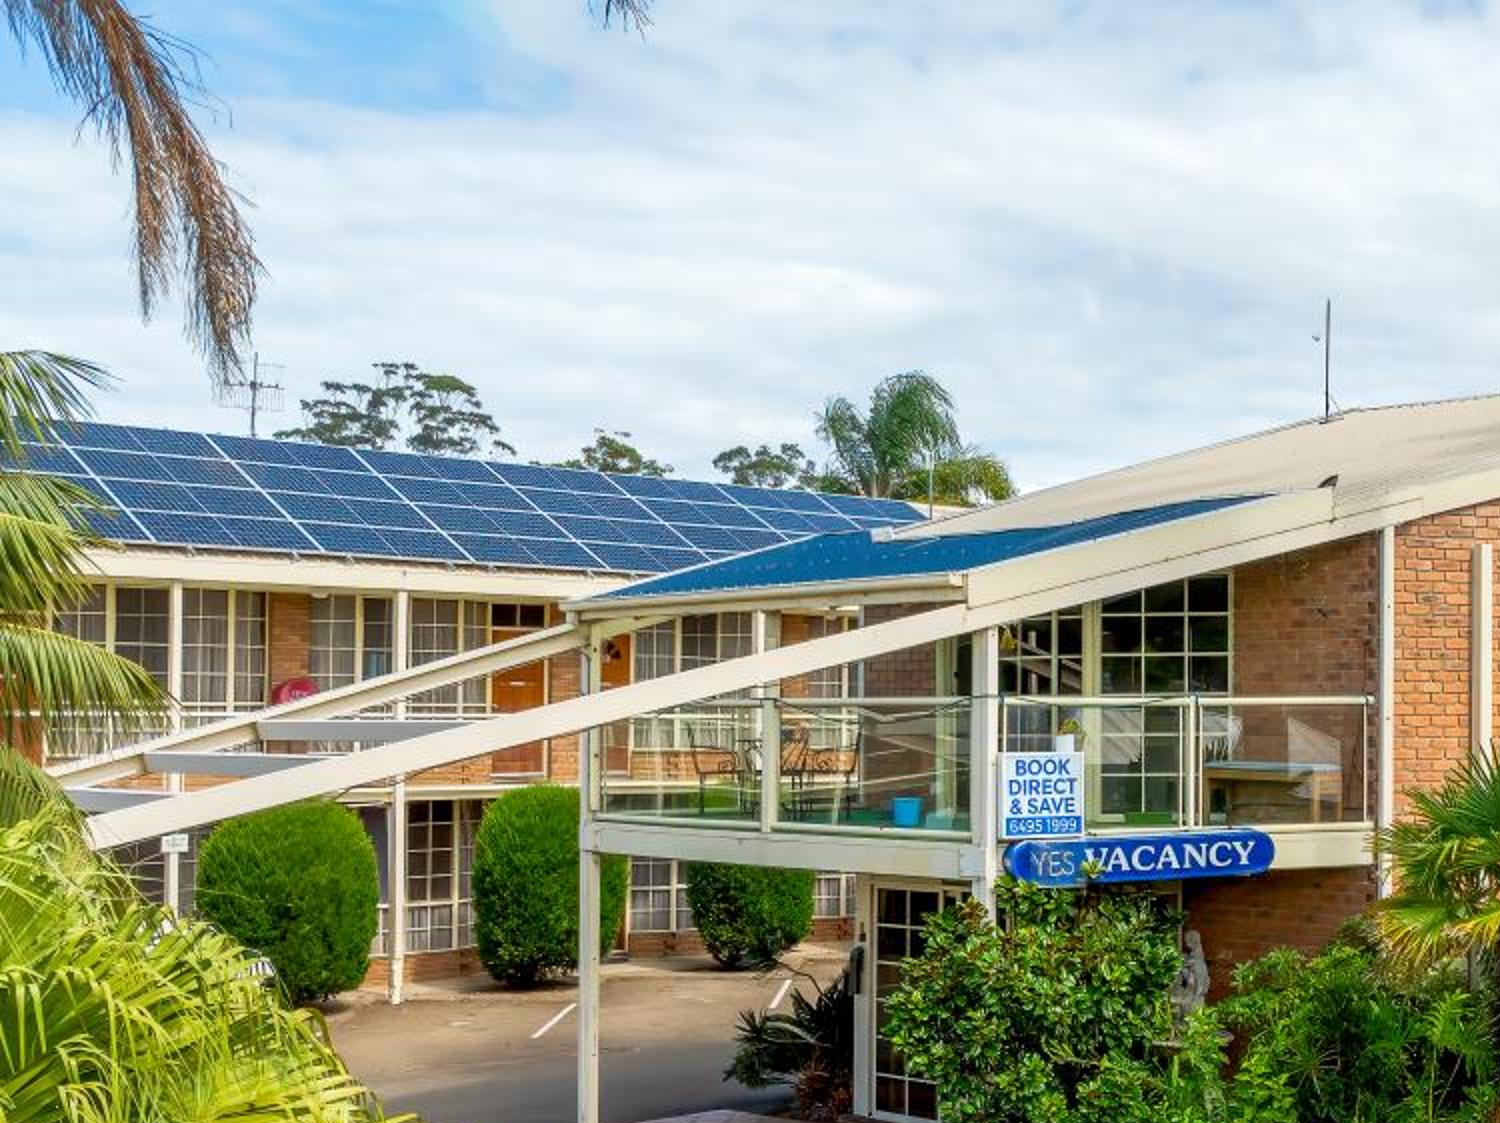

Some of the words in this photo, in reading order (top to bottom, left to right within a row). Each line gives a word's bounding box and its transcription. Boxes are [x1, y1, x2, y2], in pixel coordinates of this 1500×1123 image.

[1015, 758, 1071, 776] BOOK
[1009, 778, 1077, 795] DIRECT
[1009, 798, 1023, 814] &
[1027, 797, 1076, 814] SAVE
[1009, 819, 1042, 832] 6495
[1046, 817, 1077, 832] 1999
[1030, 850, 1076, 877] YES
[1083, 841, 1255, 875] VACANCY
